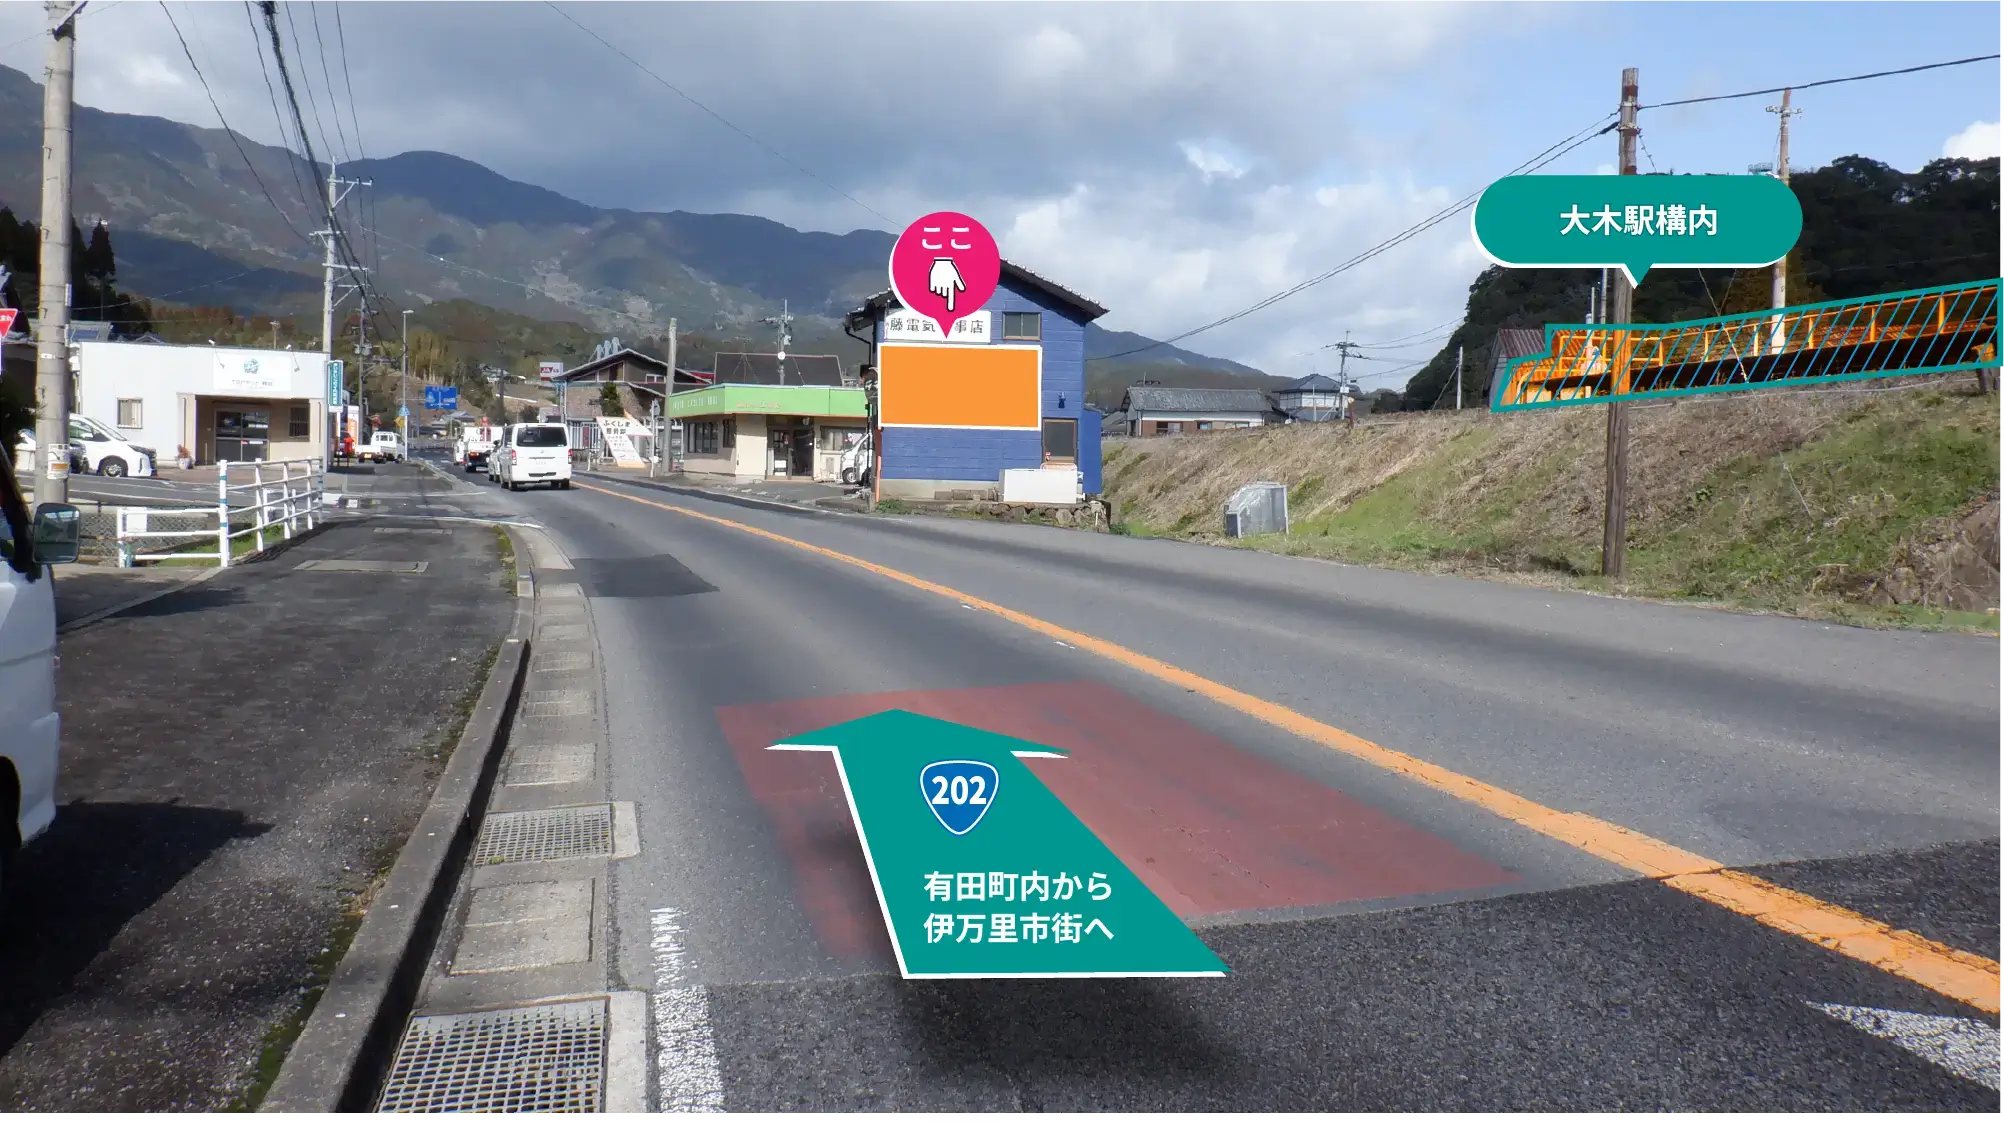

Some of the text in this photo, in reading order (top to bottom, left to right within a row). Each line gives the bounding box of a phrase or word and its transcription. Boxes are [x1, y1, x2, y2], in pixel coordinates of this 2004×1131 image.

[889, 317, 984, 334] 藤電気事店
[603, 419, 631, 428] ふくしま
